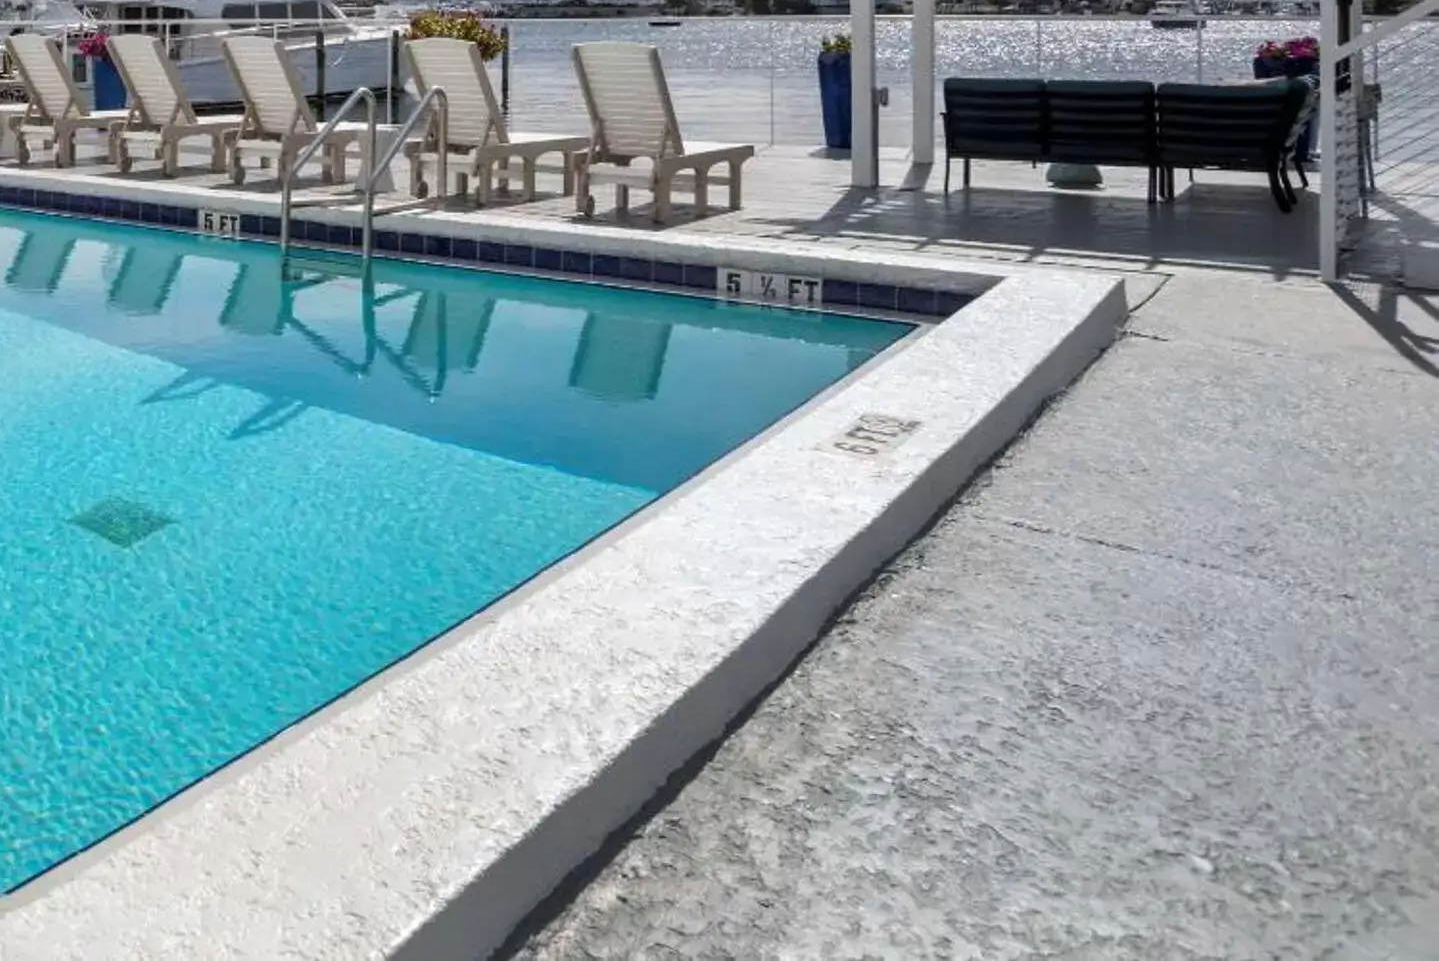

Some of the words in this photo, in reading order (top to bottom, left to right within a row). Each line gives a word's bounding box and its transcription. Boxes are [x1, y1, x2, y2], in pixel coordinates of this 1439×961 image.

[204, 212, 214, 231] 5
[219, 215, 238, 231] FT
[726, 272, 742, 293] 5
[788, 278, 819, 302] FT
